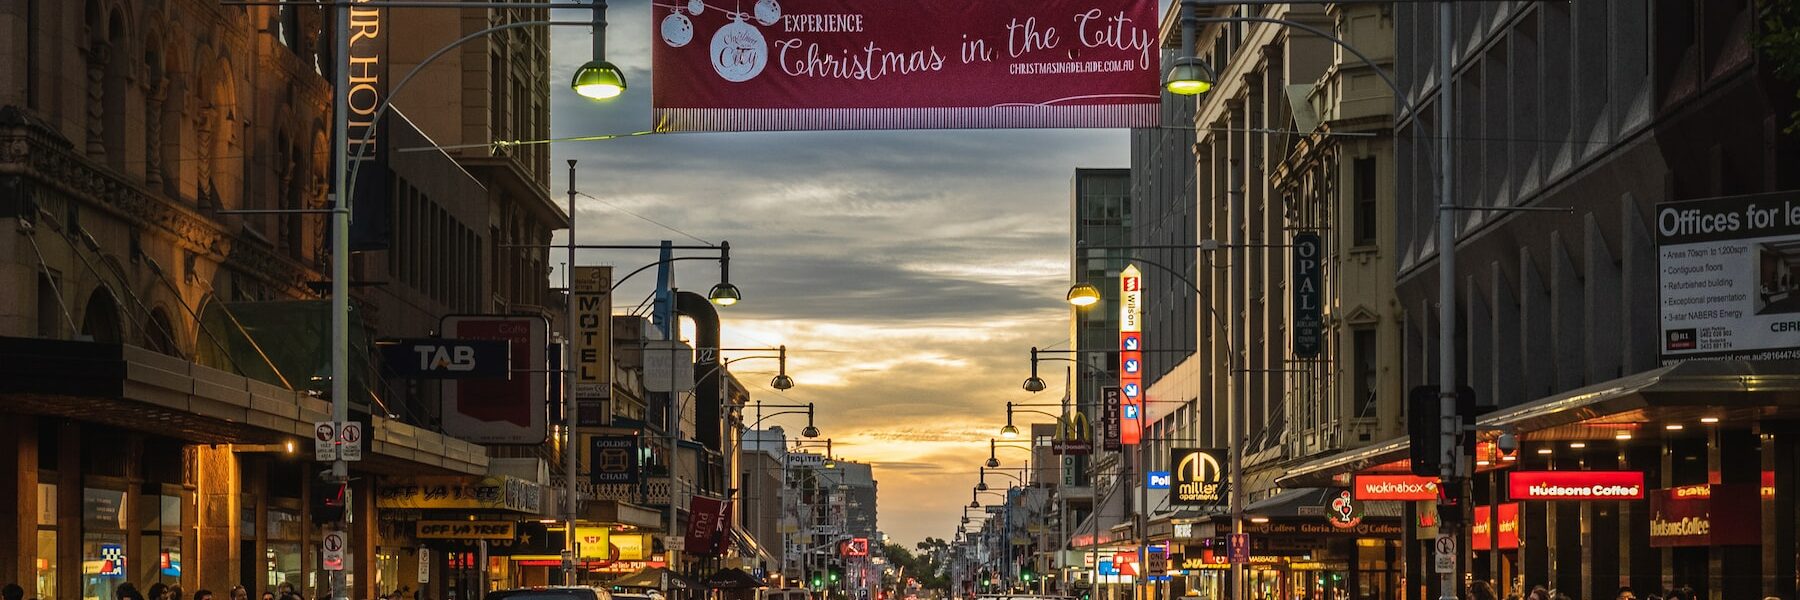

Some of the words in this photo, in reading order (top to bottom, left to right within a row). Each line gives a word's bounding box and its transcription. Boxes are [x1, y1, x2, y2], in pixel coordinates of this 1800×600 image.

[350, 0, 379, 47] IR
[784, 14, 863, 33] EXPERIENCE
[775, 38, 946, 81] Christmas
[961, 34, 991, 64] in
[1006, 16, 1060, 59] the
[1074, 8, 1154, 71] City
[719, 47, 758, 74] City
[1009, 60, 1135, 75] CHRISTMASINADELAIDE.COM.AU
[348, 55, 379, 172] HOTEL
[1658, 207, 1740, 237] Offices
[1746, 204, 1779, 230] for
[1785, 201, 1800, 227] le
[1667, 250, 1687, 259] Areas
[1688, 249, 1709, 259] 70sqm
[1710, 248, 1717, 256] to
[1298, 242, 1316, 310] OPAL
[1668, 266, 1705, 276] Contiguous
[1706, 263, 1723, 272] floors
[1668, 281, 1707, 291] Refurbished
[1708, 278, 1733, 288] building
[1669, 297, 1706, 307] Exceptional
[1706, 293, 1747, 304] presentation
[1689, 311, 1718, 321] NABERS
[1720, 309, 1743, 320] Energy
[579, 297, 600, 380] MOTEL
[413, 345, 476, 371] TAB
[1107, 391, 1118, 438] POLITES
[596, 440, 632, 448] GOLDEN
[790, 455, 822, 463] POLITES
[599, 473, 629, 481] CHAIN
[1065, 457, 1073, 485] OTE
[1151, 475, 1170, 486] Poli
[1366, 481, 1424, 494] wokinabox
[380, 484, 418, 501] OFF
[424, 485, 450, 501] YA
[1179, 483, 1218, 494] miller
[1529, 484, 1592, 497] Hudsons
[1592, 485, 1639, 497] Coffee
[1179, 493, 1219, 501] apartments
[420, 524, 449, 535] OFF
[452, 524, 473, 535] YA
[472, 524, 510, 535] TREE
[695, 512, 708, 539] PUB
[1301, 523, 1329, 533] Gloria
[1369, 523, 1403, 533] Coffees
[1650, 518, 1682, 537] Hudsons
[1682, 517, 1710, 536] Coffee
